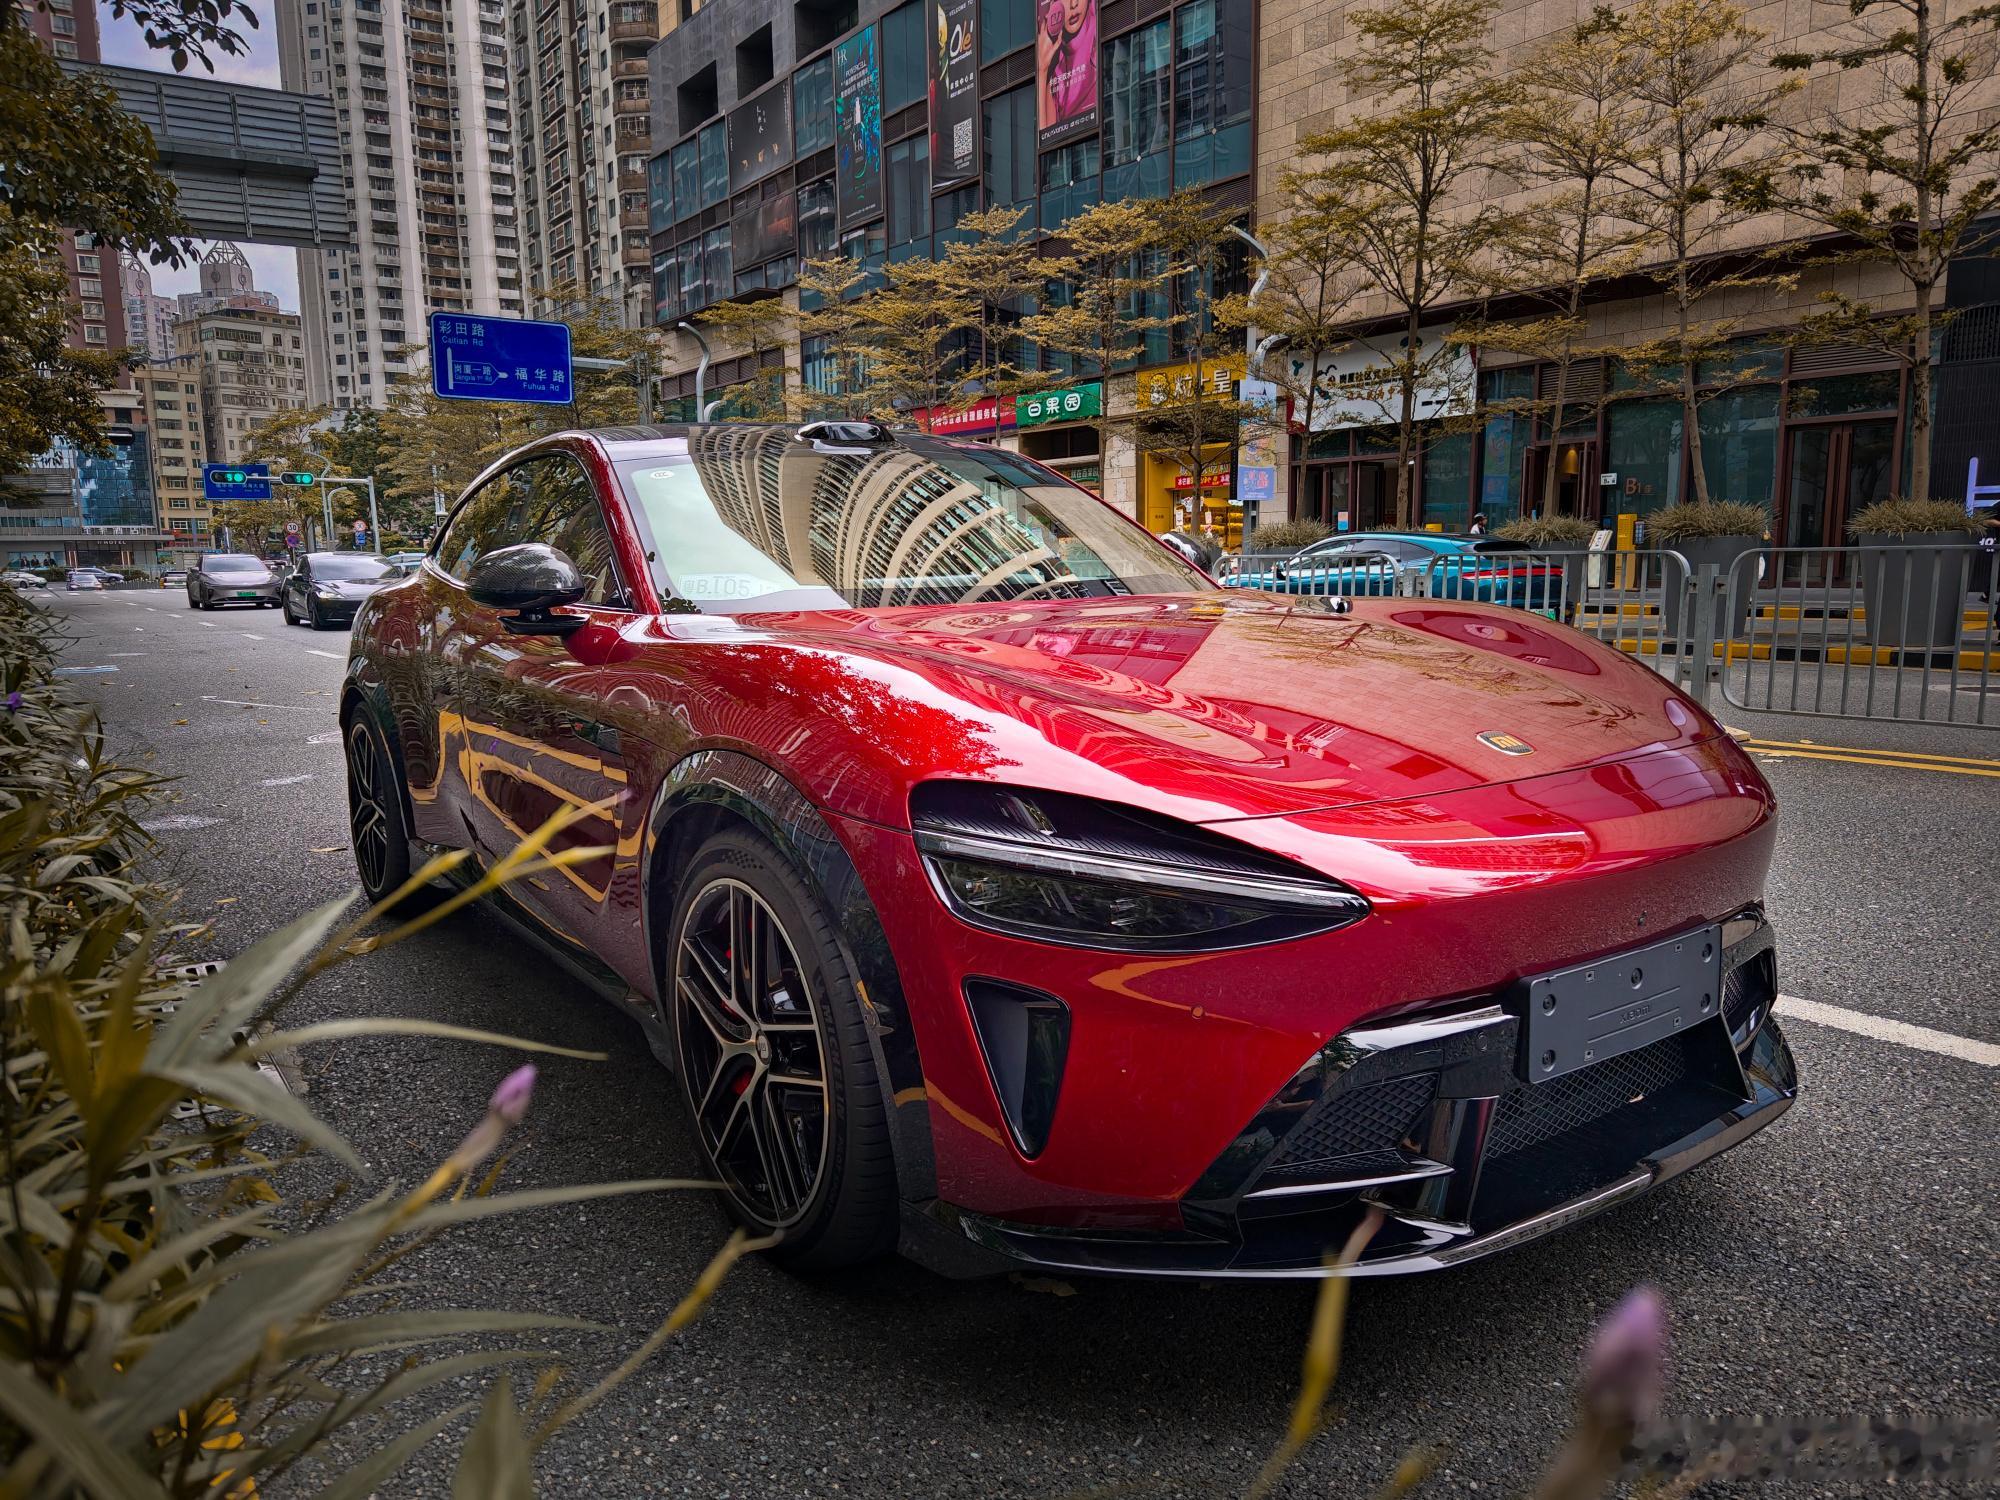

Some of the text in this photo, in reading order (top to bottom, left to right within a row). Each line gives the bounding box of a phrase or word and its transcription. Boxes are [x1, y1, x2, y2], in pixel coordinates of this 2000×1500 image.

[439, 320, 485, 337] 彩田路
[441, 336, 484, 346] Caitian Rd
[515, 367, 565, 383] 福华路
[523, 381, 560, 392] Fuhua Rd
[1028, 392, 1081, 417] 百果园
